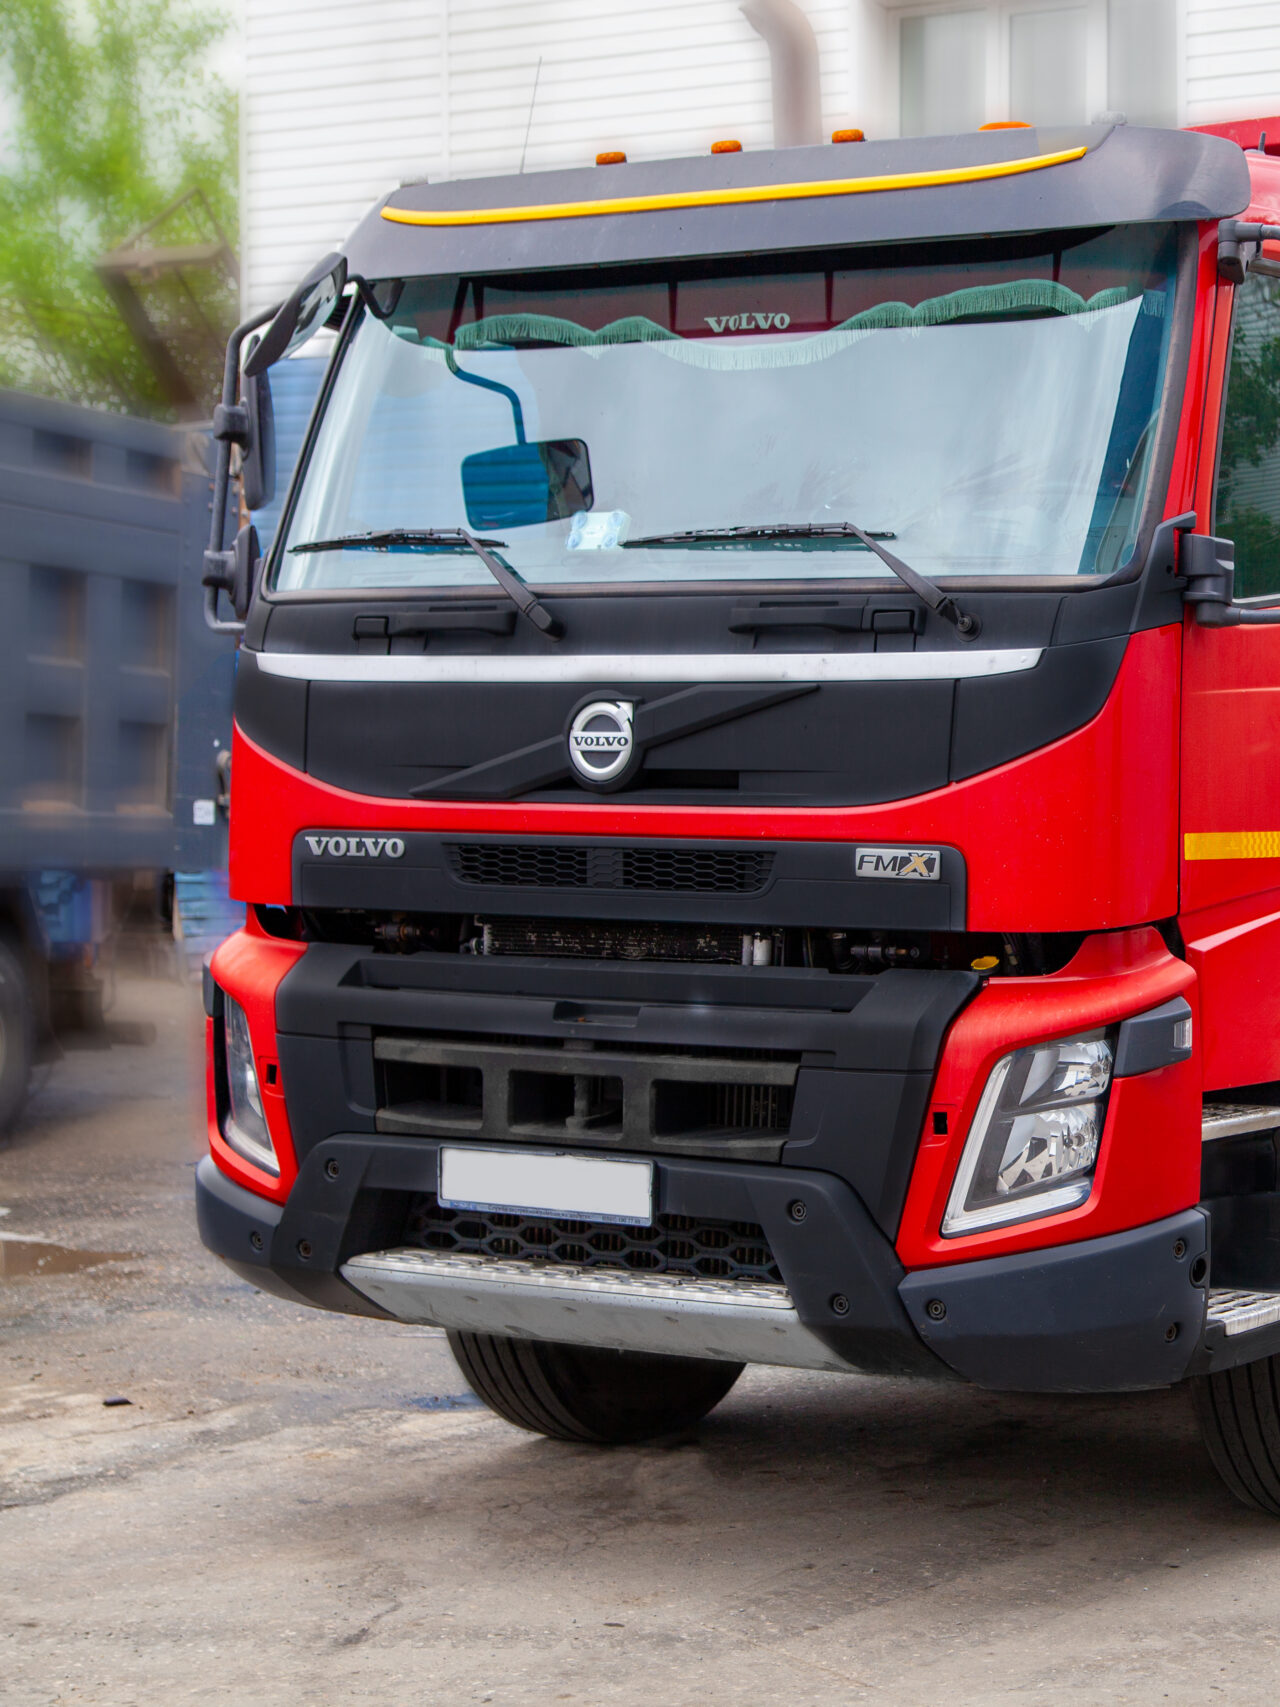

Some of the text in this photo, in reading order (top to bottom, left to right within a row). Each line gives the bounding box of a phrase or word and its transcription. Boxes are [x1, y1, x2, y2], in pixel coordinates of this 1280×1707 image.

[704, 313, 790, 333] VOLVO
[573, 736, 629, 747] VOLVO
[304, 836, 405, 858] VOLVO
[857, 852, 937, 877] FMX
